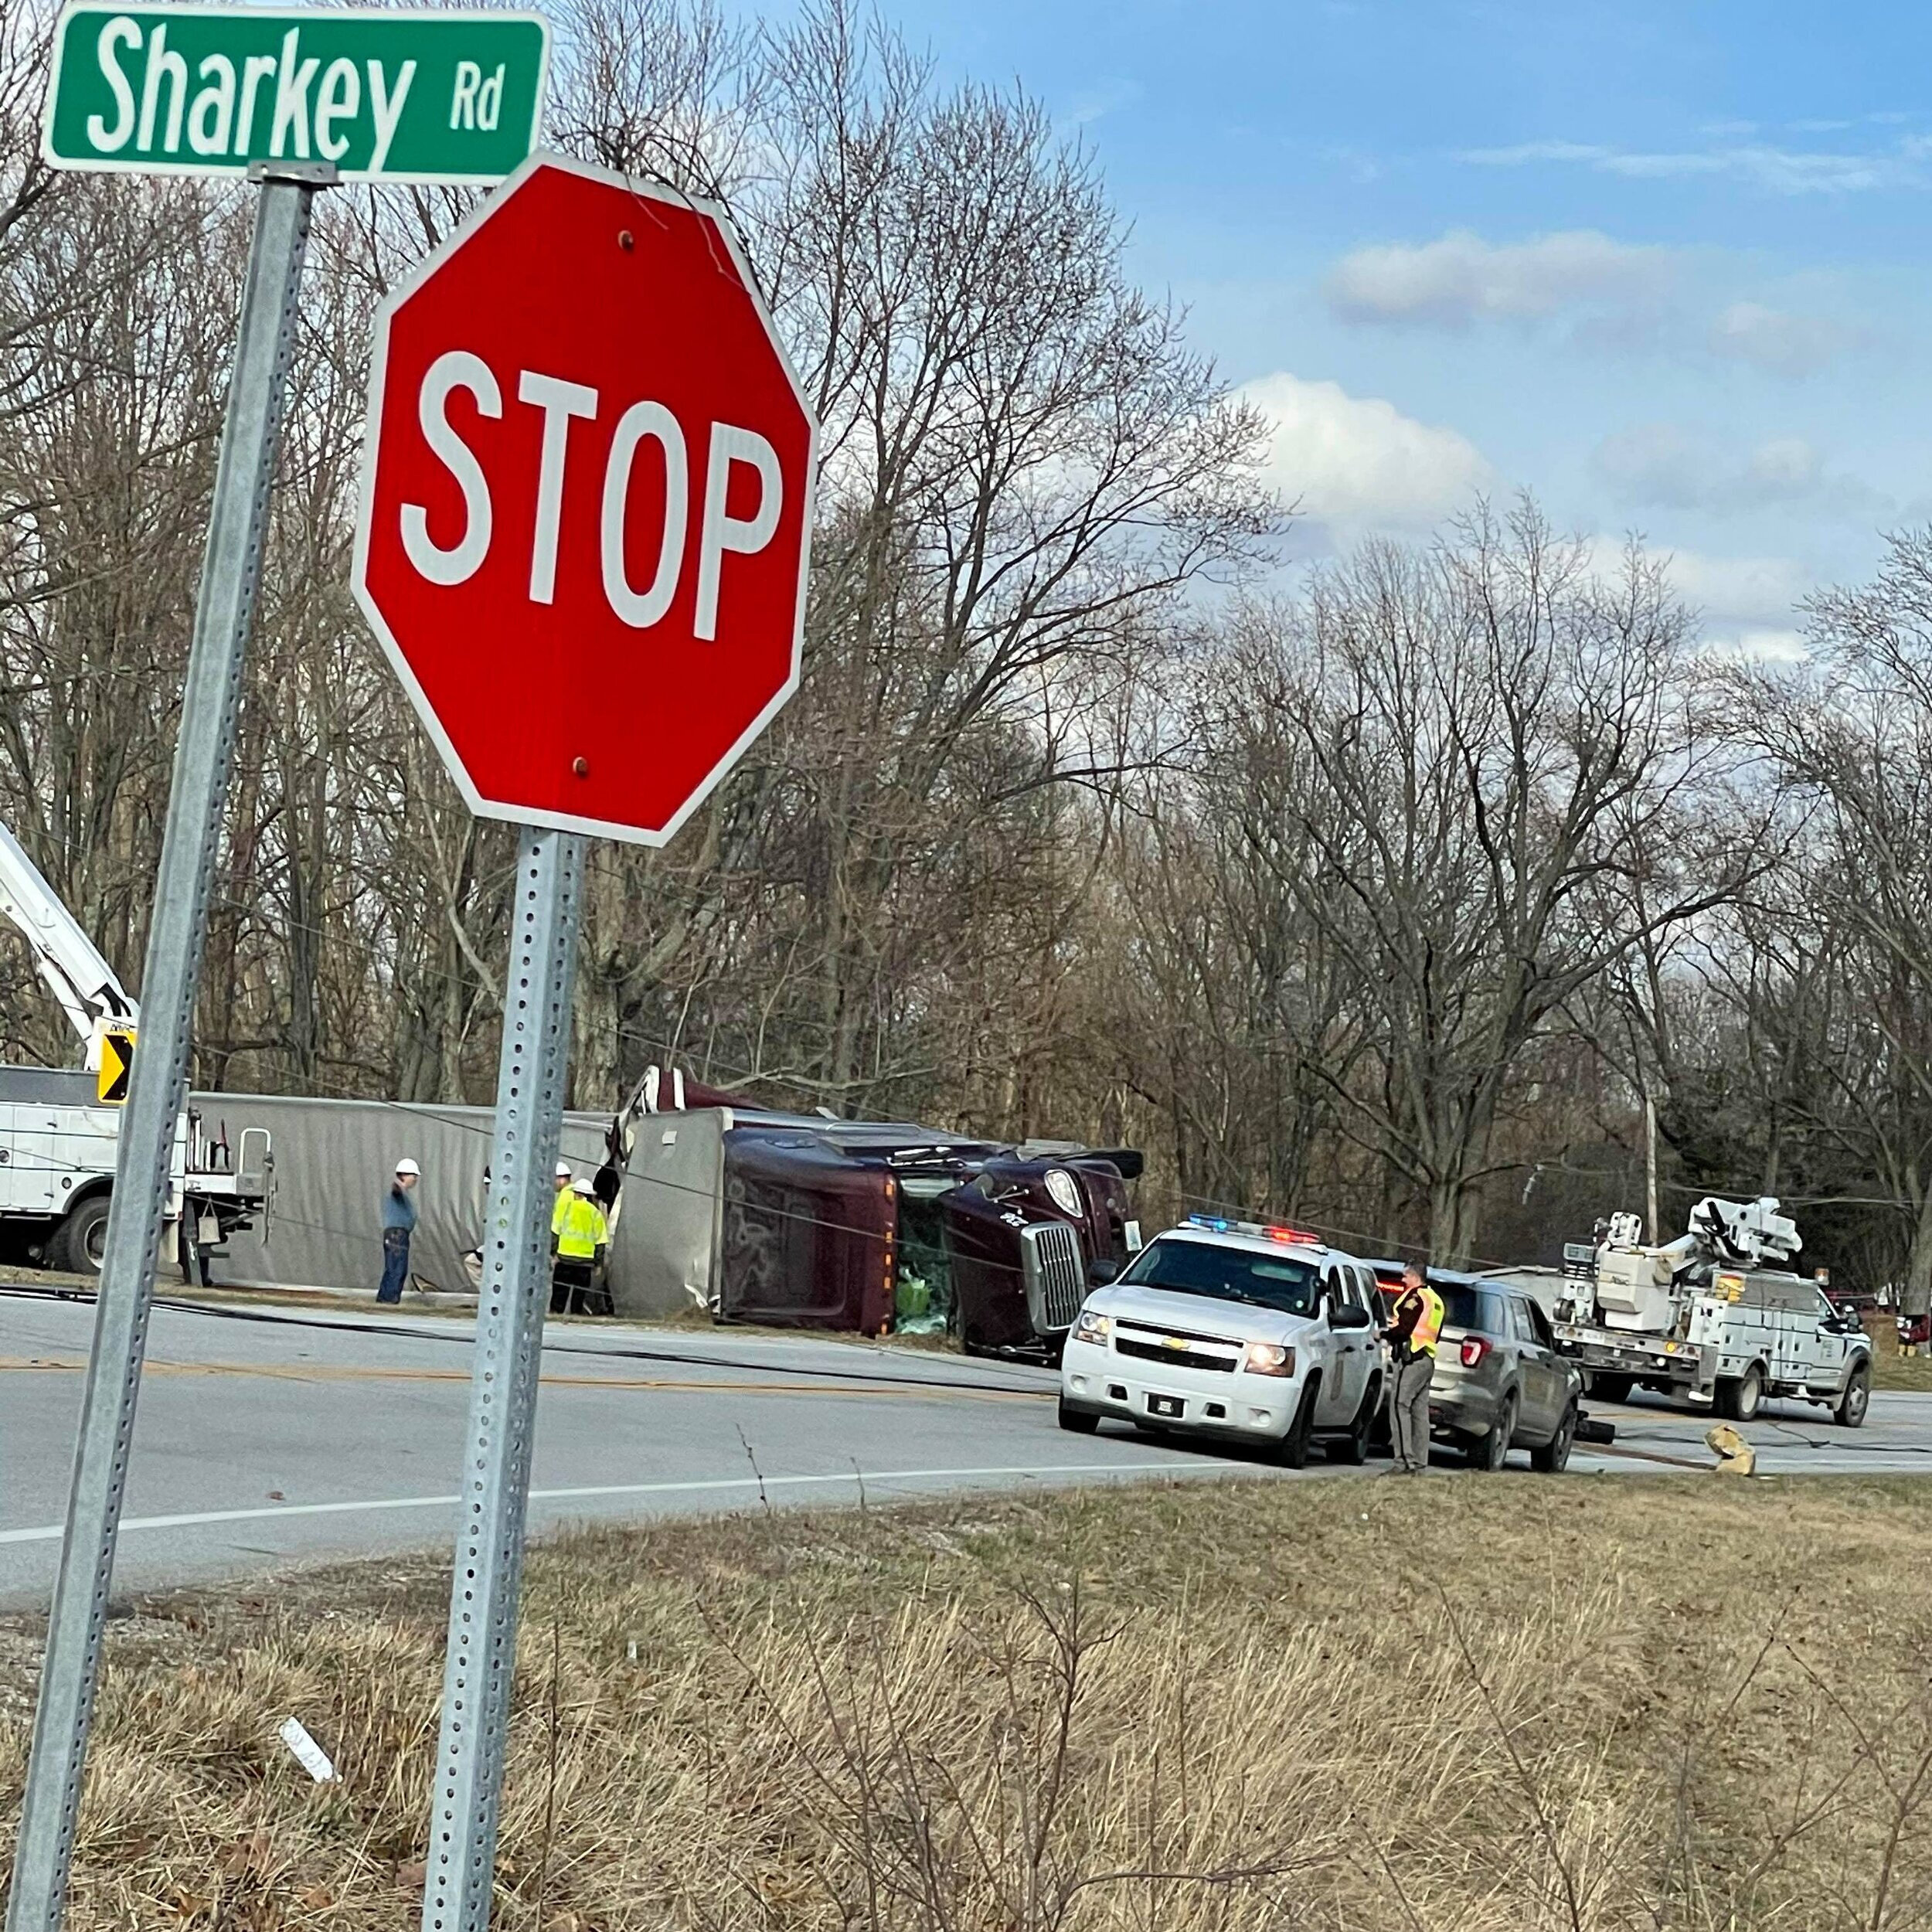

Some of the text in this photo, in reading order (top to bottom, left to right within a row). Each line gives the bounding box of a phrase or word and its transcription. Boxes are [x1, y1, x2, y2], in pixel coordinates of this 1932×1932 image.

[87, 18, 505, 172] Sharkey Rd
[400, 350, 784, 641] STOP
